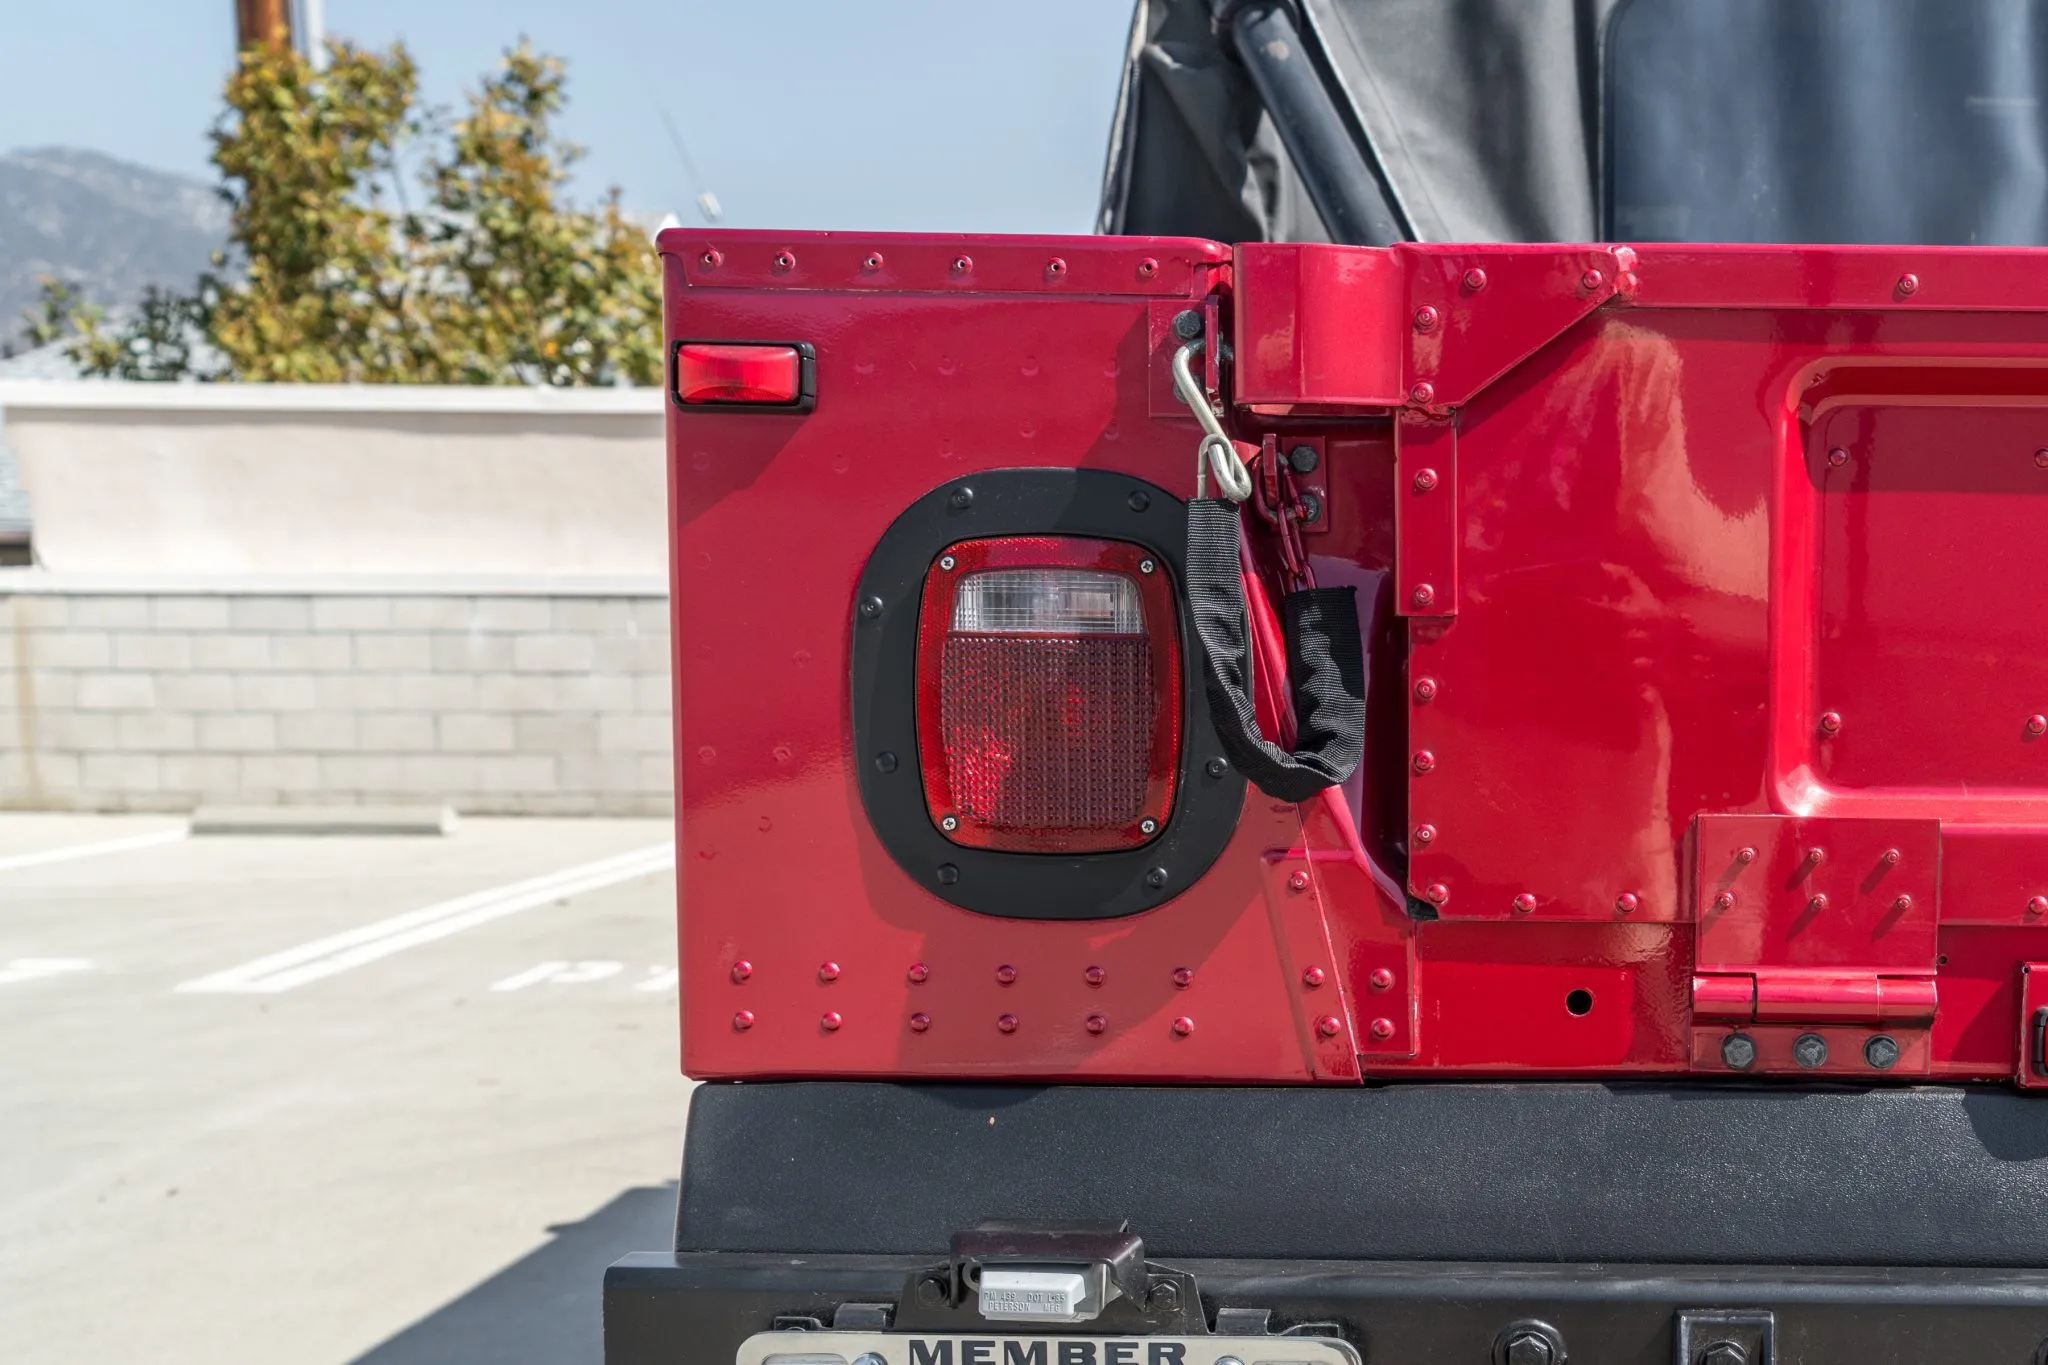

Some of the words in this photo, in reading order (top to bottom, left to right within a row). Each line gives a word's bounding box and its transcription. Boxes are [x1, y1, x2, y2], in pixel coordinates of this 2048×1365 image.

[1027, 1293, 1043, 1303] DOT
[988, 1301, 1031, 1312] PETERSON
[908, 1339, 1187, 1365] MEMBER
